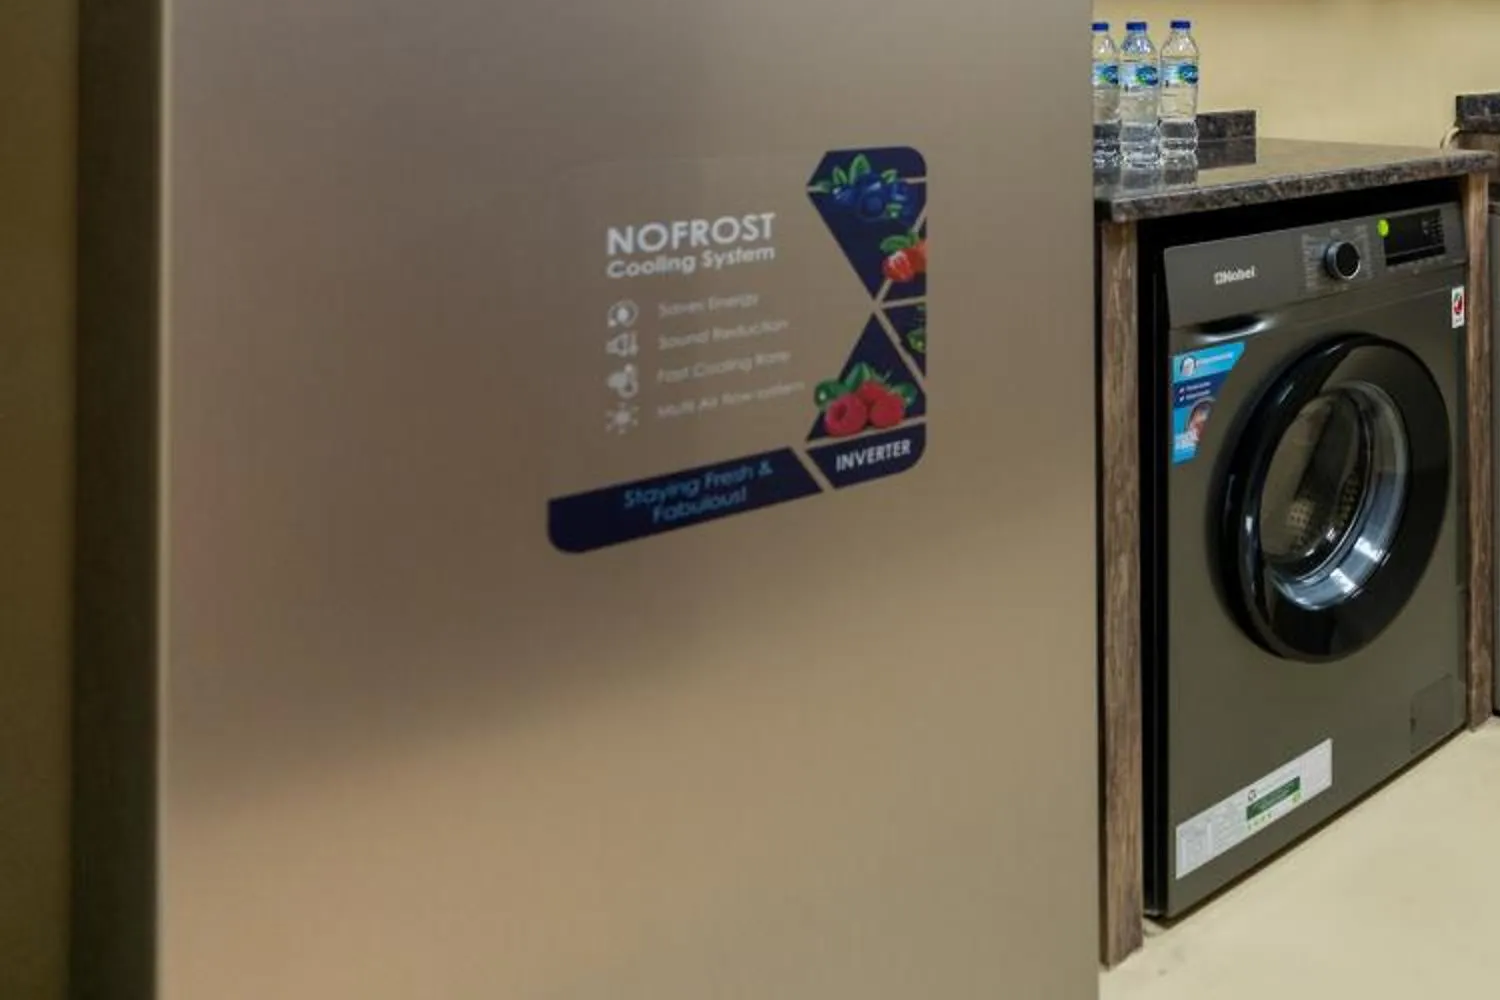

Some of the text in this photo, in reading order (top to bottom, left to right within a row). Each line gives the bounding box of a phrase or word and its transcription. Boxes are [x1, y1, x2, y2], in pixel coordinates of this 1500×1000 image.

[607, 212, 776, 256] NOFROST
[606, 246, 776, 279] Cooling System
[835, 439, 912, 473] INVERTER
[623, 460, 775, 511] Staying Fresh &
